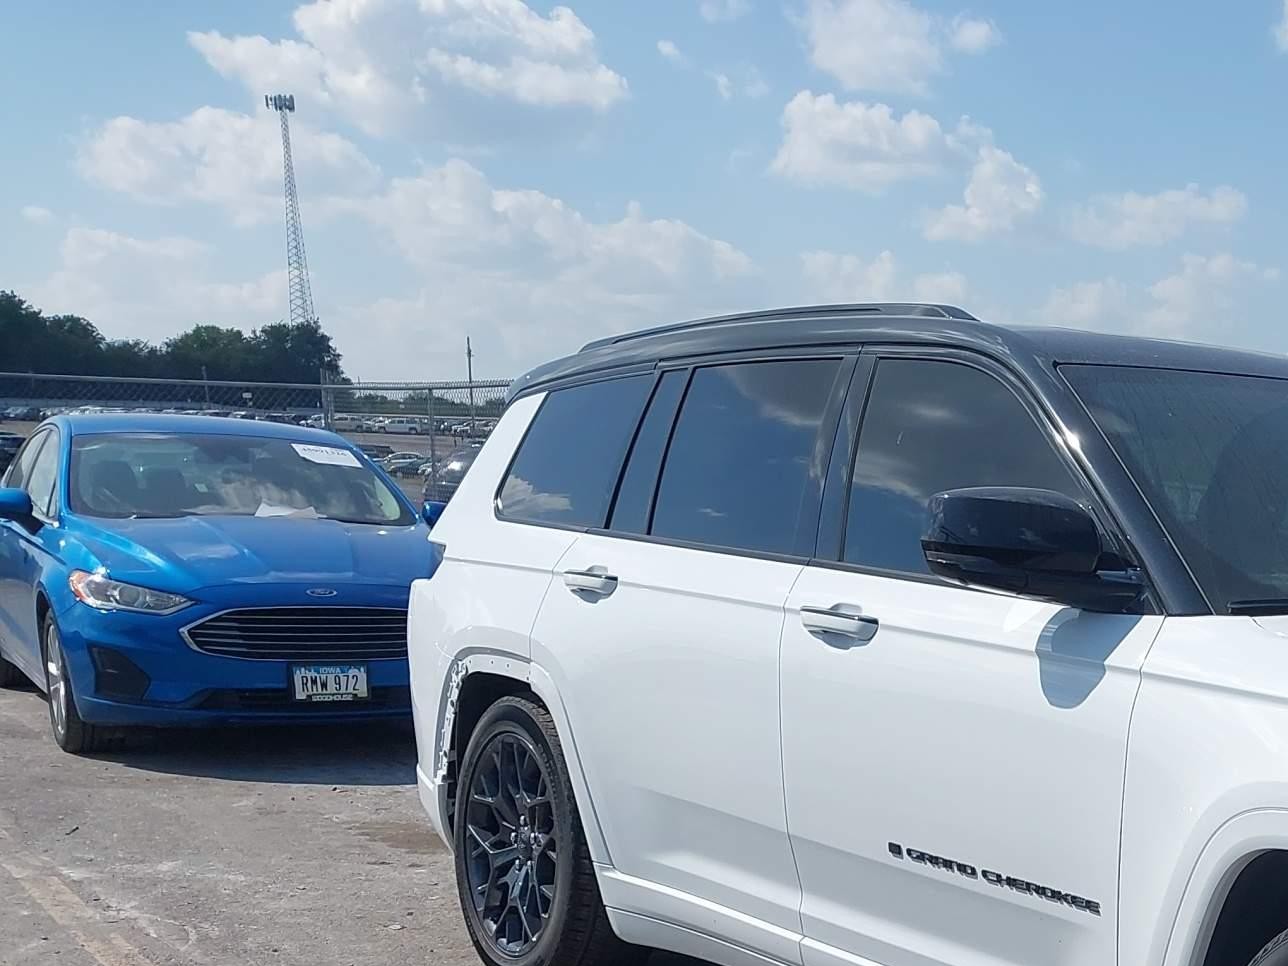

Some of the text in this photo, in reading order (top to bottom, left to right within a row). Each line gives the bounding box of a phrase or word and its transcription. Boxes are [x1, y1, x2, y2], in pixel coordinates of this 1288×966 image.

[301, 674, 360, 692] RMW 972
[906, 848, 1101, 916] GRAND CHEROKEE
